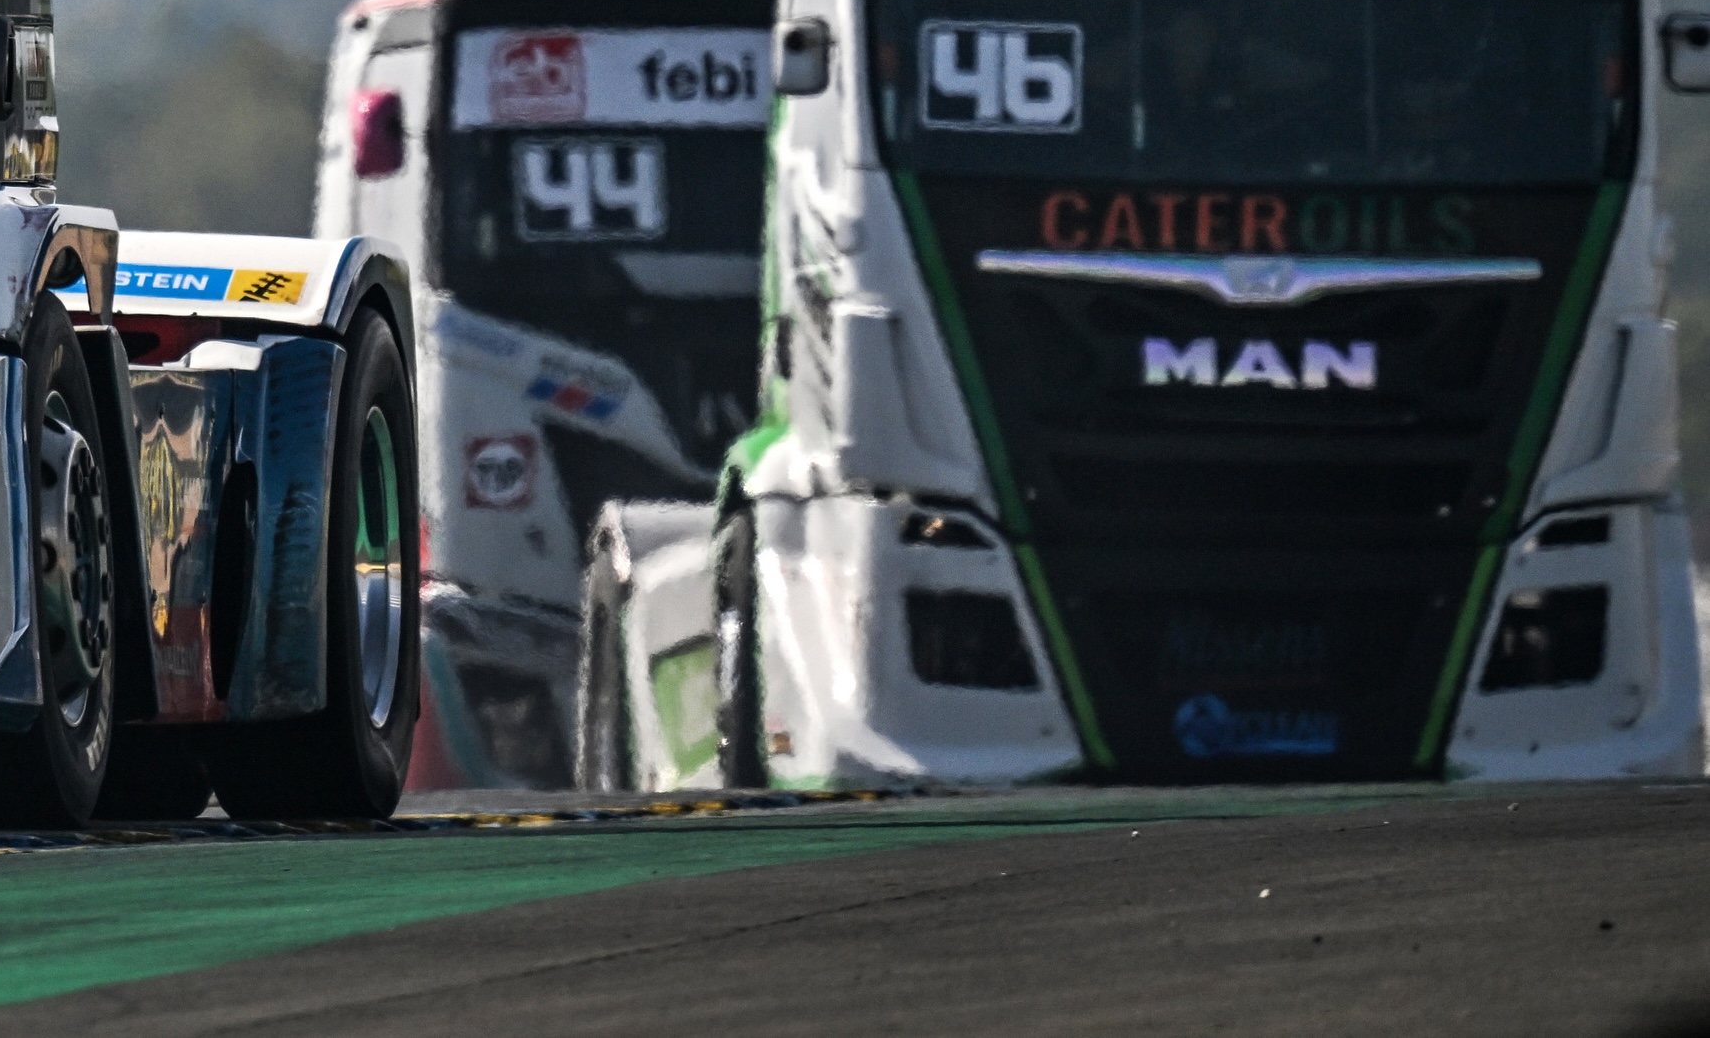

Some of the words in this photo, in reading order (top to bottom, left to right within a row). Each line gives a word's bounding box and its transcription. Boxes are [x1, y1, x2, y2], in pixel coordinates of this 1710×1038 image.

[638, 48, 758, 102] febi
[931, 32, 1074, 125] 46
[524, 142, 664, 230] 44
[114, 271, 210, 291] STEIN
[1141, 337, 1379, 390] MAN
